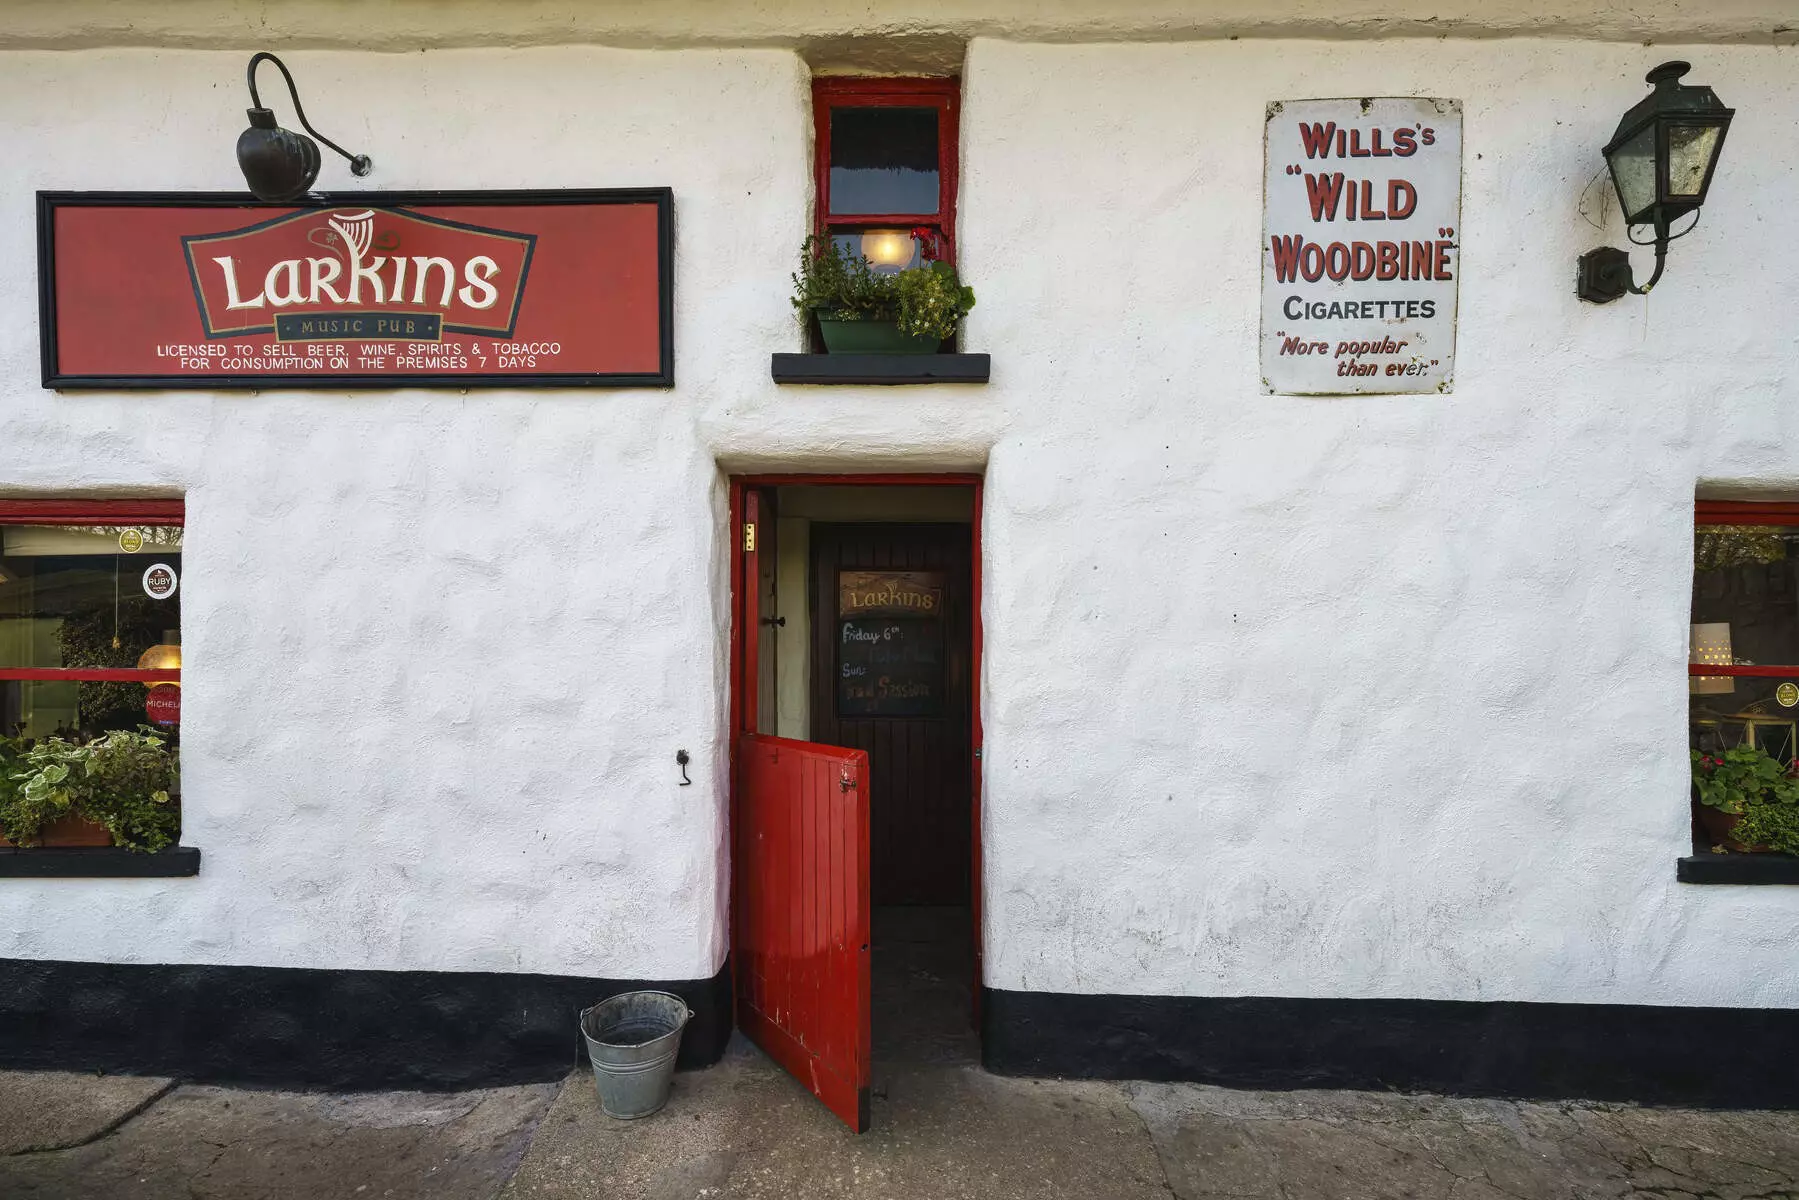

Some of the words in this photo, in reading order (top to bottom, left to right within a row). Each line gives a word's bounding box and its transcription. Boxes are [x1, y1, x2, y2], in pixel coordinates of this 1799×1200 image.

[1283, 295, 1436, 320] CIGARETTES
[301, 320, 362, 333] MUSIC
[377, 320, 416, 334] PUB
[157, 344, 227, 357] LICENSED
[234, 344, 254, 356] TO
[263, 344, 296, 356] SELL
[408, 343, 461, 355] SPIRITS
[471, 343, 481, 355] &
[491, 342, 561, 355] TOBACCO
[1334, 335, 1409, 359] popular
[181, 357, 210, 370] FOR
[221, 357, 323, 370] CONSUMPTION
[330, 357, 349, 369] ON
[357, 357, 385, 369] THE
[396, 356, 468, 369] PREMISES
[478, 356, 487, 368] 7
[498, 356, 536, 368] DAYS
[1337, 358, 1378, 376] than
[148, 577, 171, 586] RUBY
[843, 622, 880, 644] Friday
